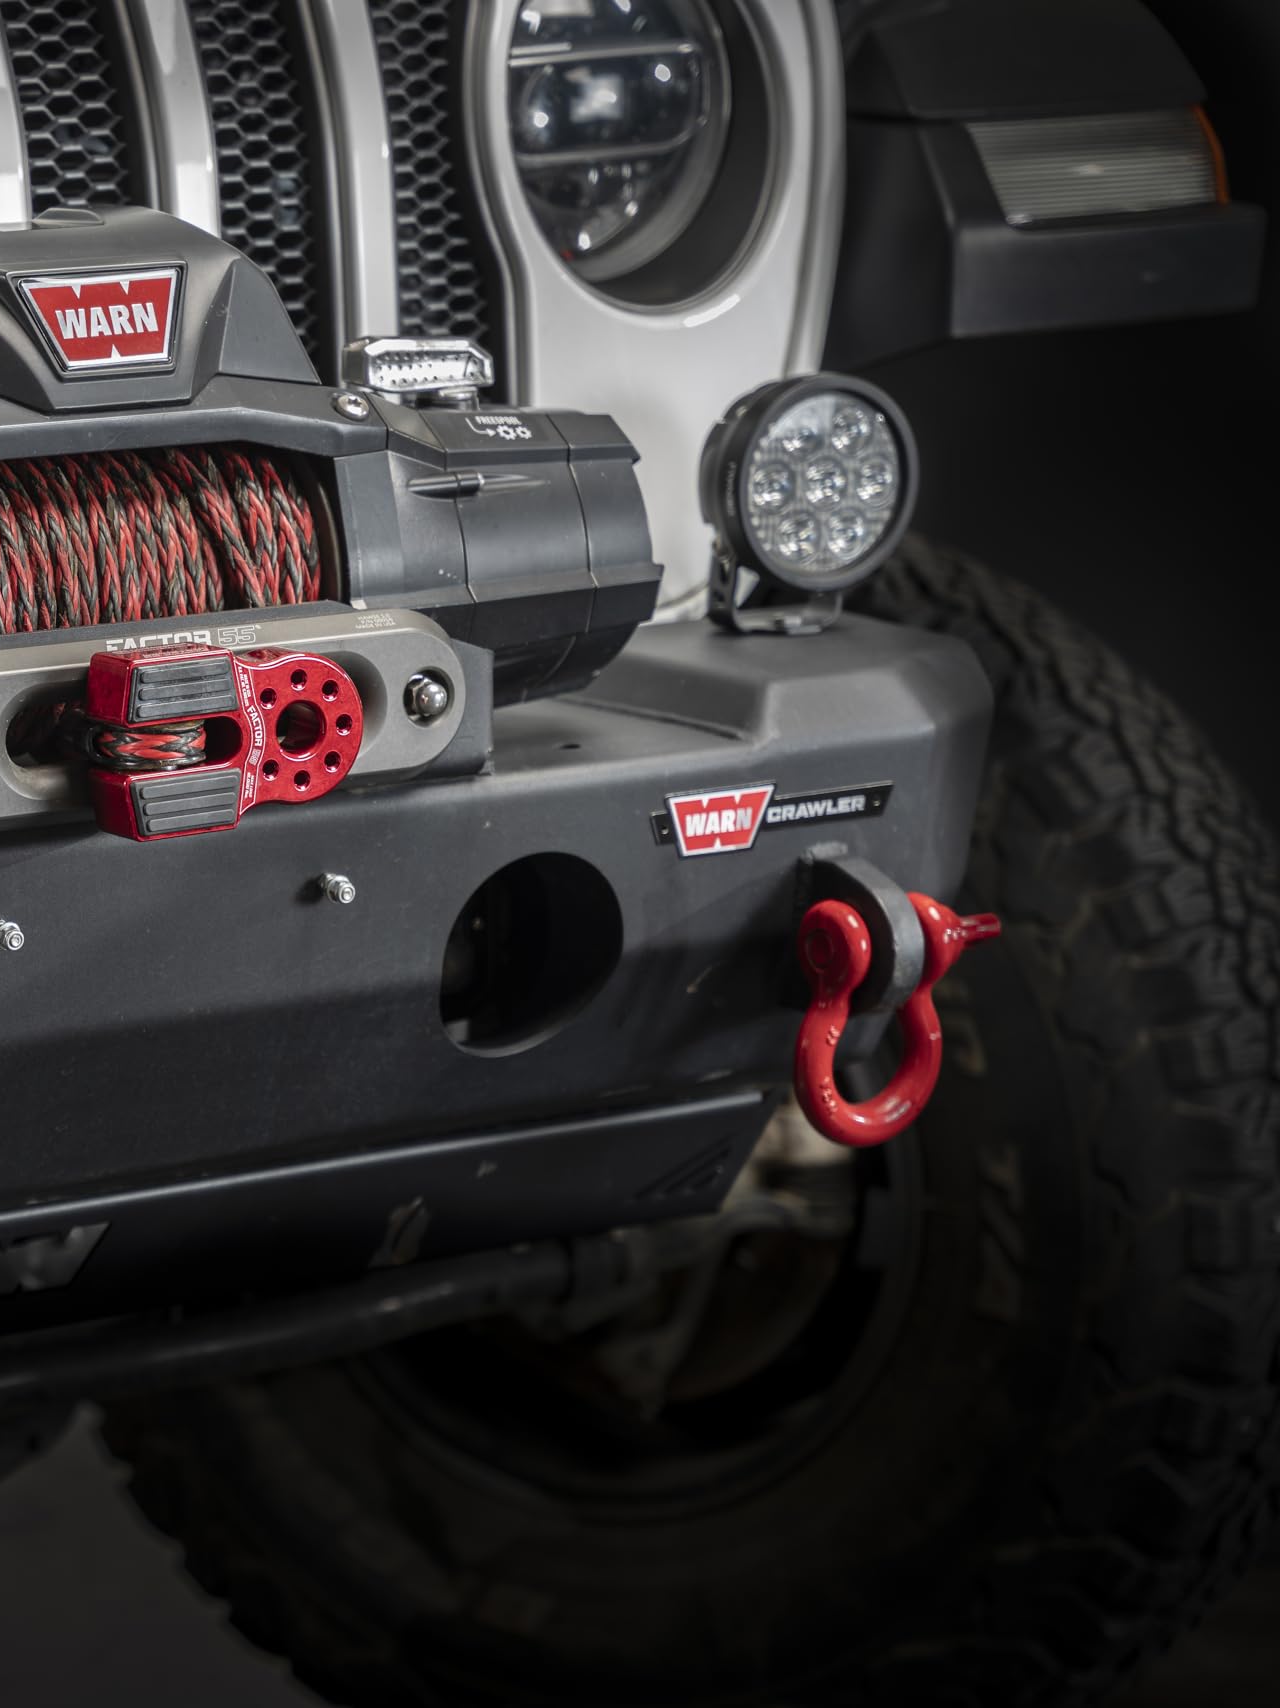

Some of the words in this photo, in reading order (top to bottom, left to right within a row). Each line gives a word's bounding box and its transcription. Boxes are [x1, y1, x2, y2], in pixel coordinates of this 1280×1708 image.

[55, 302, 159, 340] WARN
[218, 625, 256, 646] 55
[247, 705, 263, 747] FACTOR
[685, 807, 753, 838] WARN
[765, 794, 867, 823] CRAWLER
